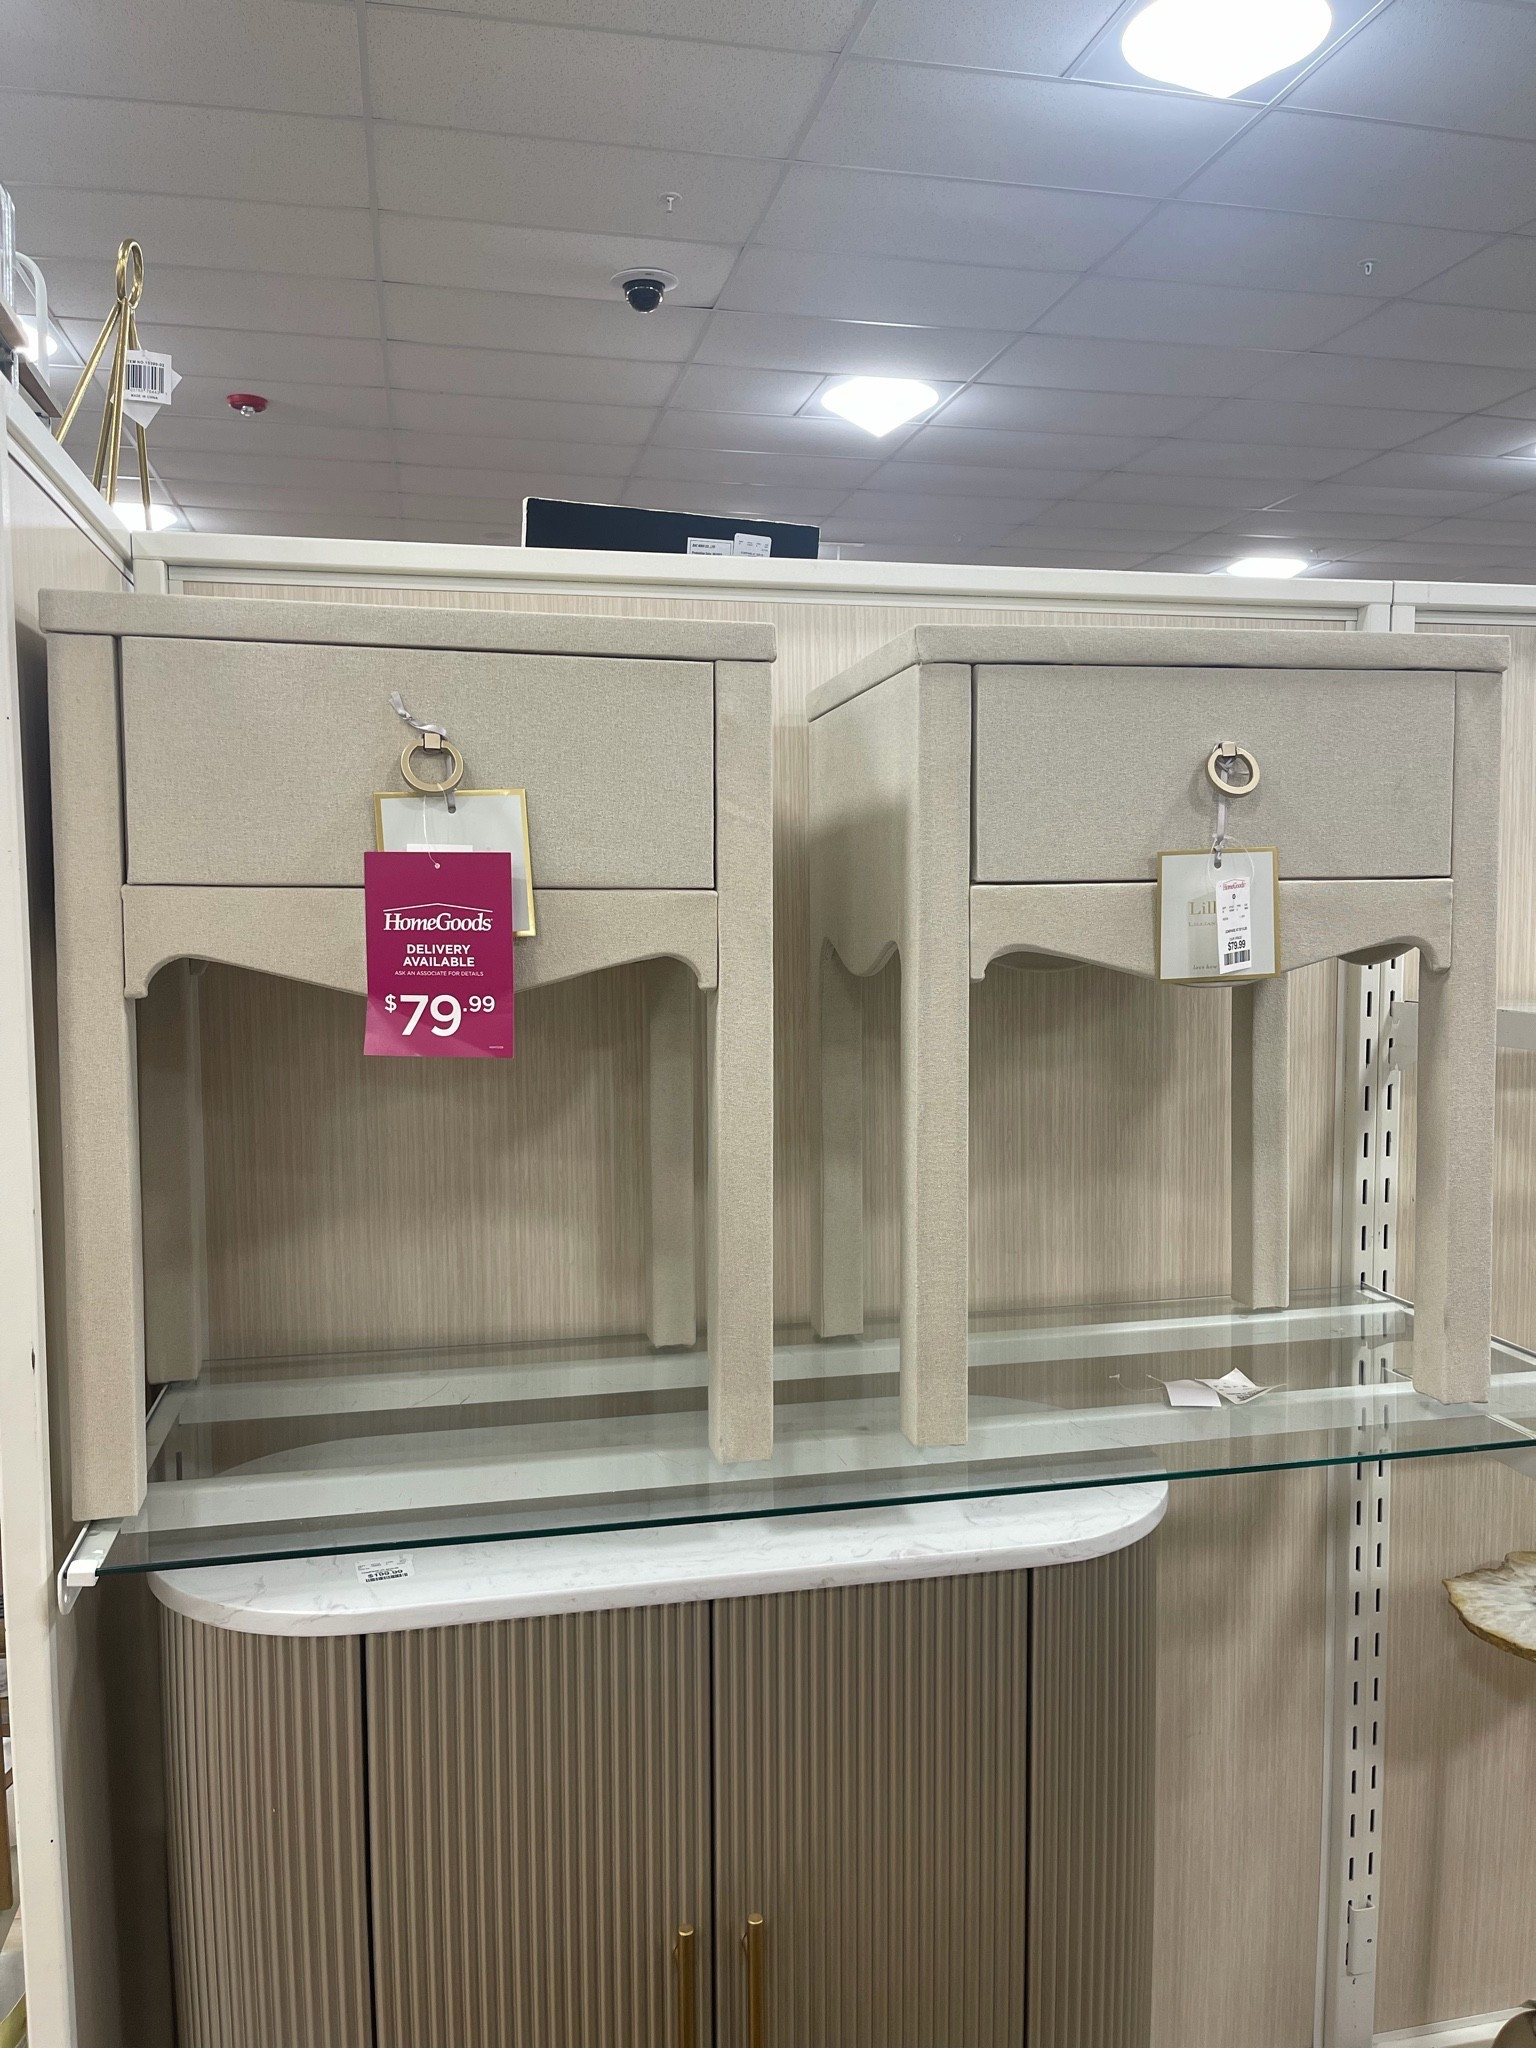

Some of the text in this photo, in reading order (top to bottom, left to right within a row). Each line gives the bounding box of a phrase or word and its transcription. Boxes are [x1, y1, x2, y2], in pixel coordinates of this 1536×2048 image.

[1188, 900, 1217, 915] Lill
[383, 912, 492, 931] HomeGoods
[406, 944, 471, 954] DELIVERY
[1227, 939, 1246, 951] $79.99
[403, 956, 475, 967] AVAILABLE
[384, 993, 496, 1037] $79.99
